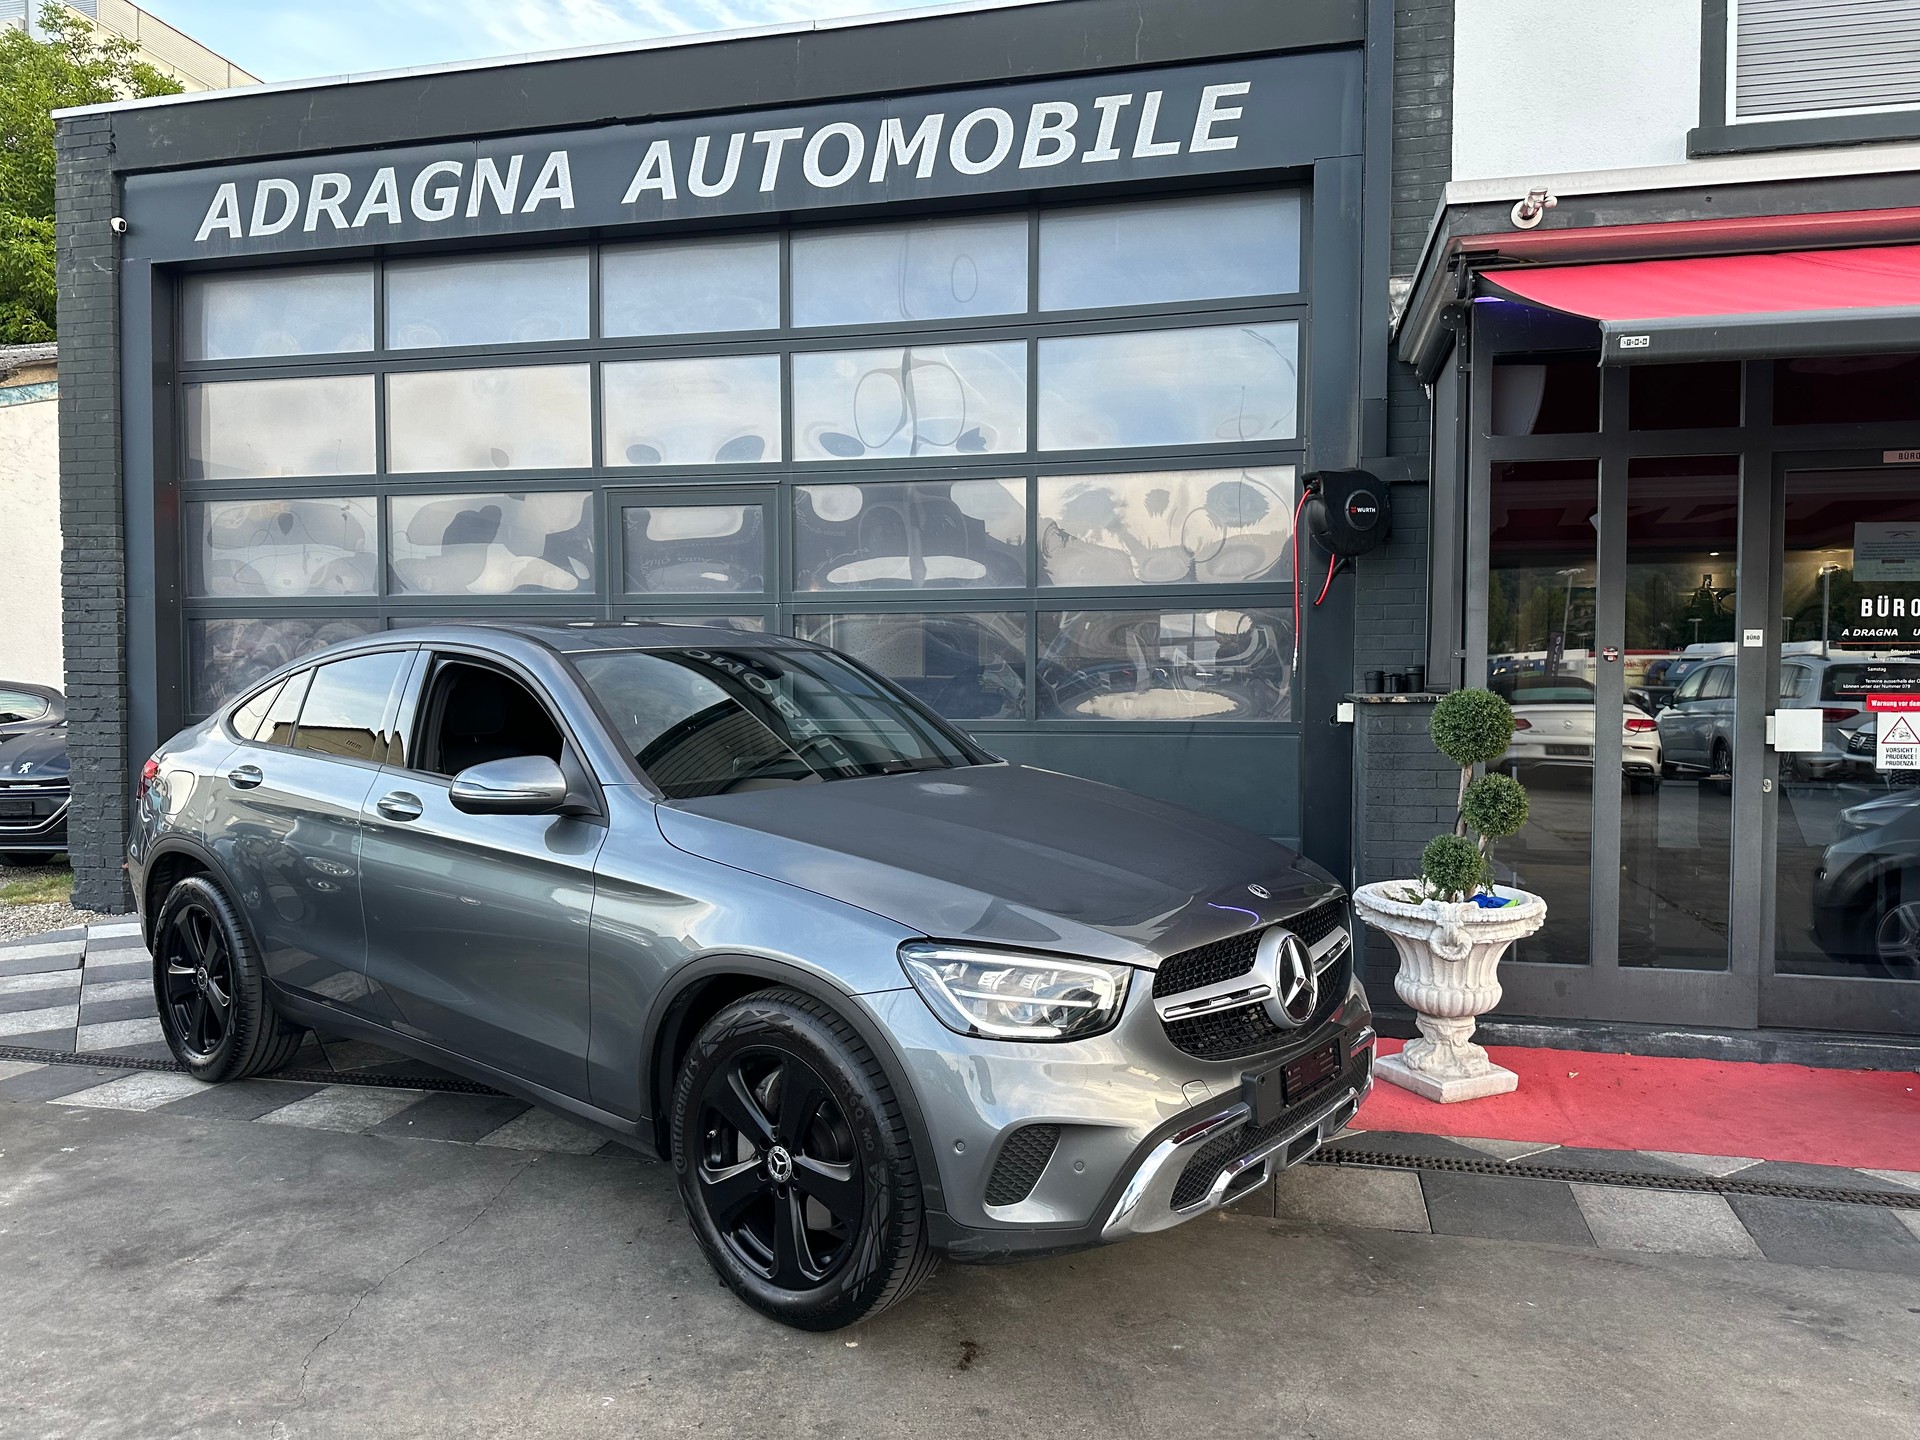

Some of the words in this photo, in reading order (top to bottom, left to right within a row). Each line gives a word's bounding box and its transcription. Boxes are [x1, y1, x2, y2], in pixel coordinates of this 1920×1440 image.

[194, 150, 575, 242] ADRAGNA
[620, 81, 1252, 204] AUTOMOBILE
[1861, 595, 1920, 617] BÜRO
